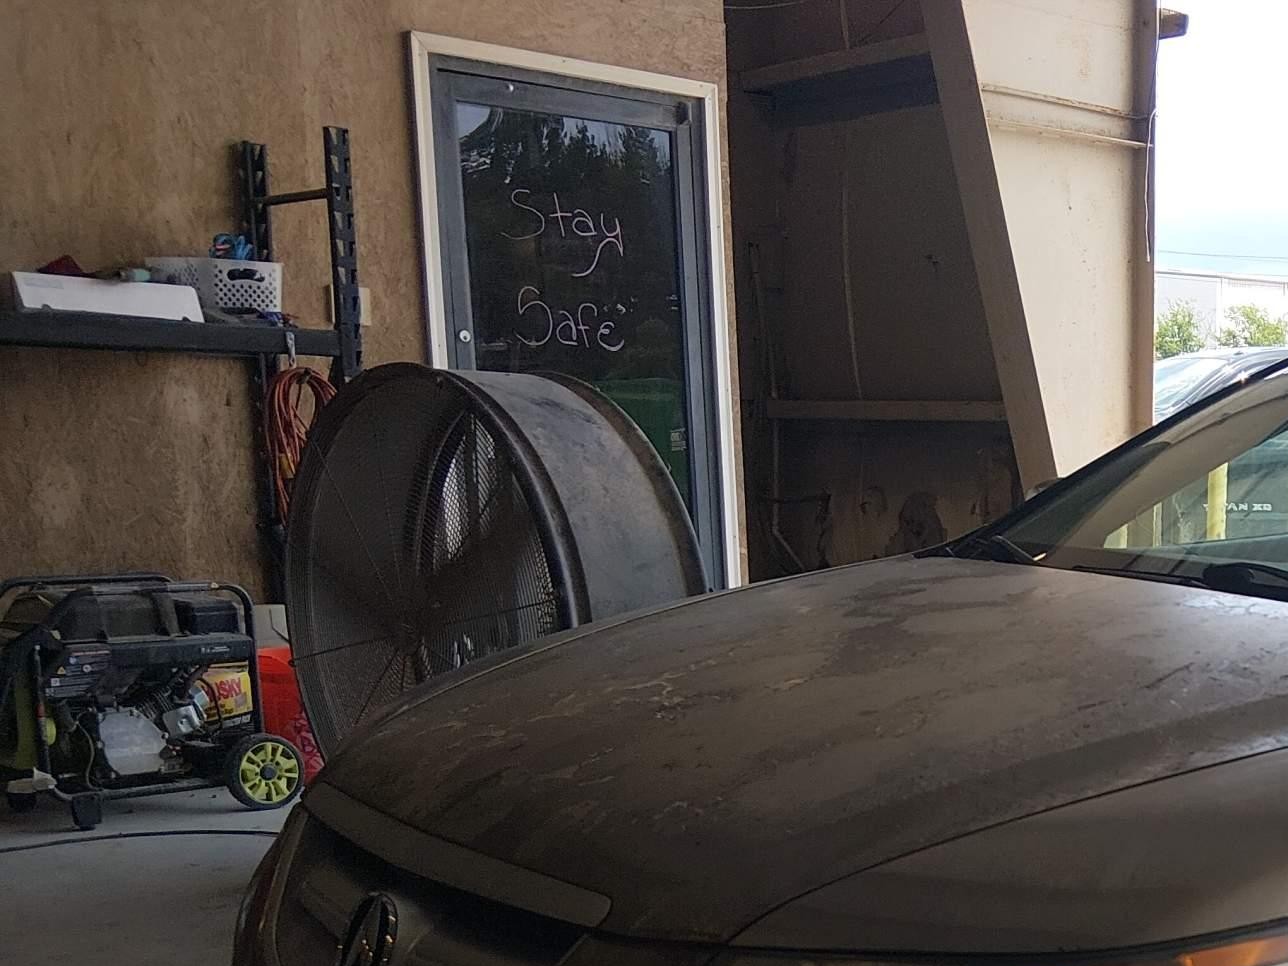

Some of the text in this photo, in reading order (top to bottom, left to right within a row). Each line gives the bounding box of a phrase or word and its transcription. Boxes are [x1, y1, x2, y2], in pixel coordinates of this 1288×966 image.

[499, 189, 624, 278] Stay
[515, 286, 625, 352] Safe
[1202, 502, 1249, 512] TAN
